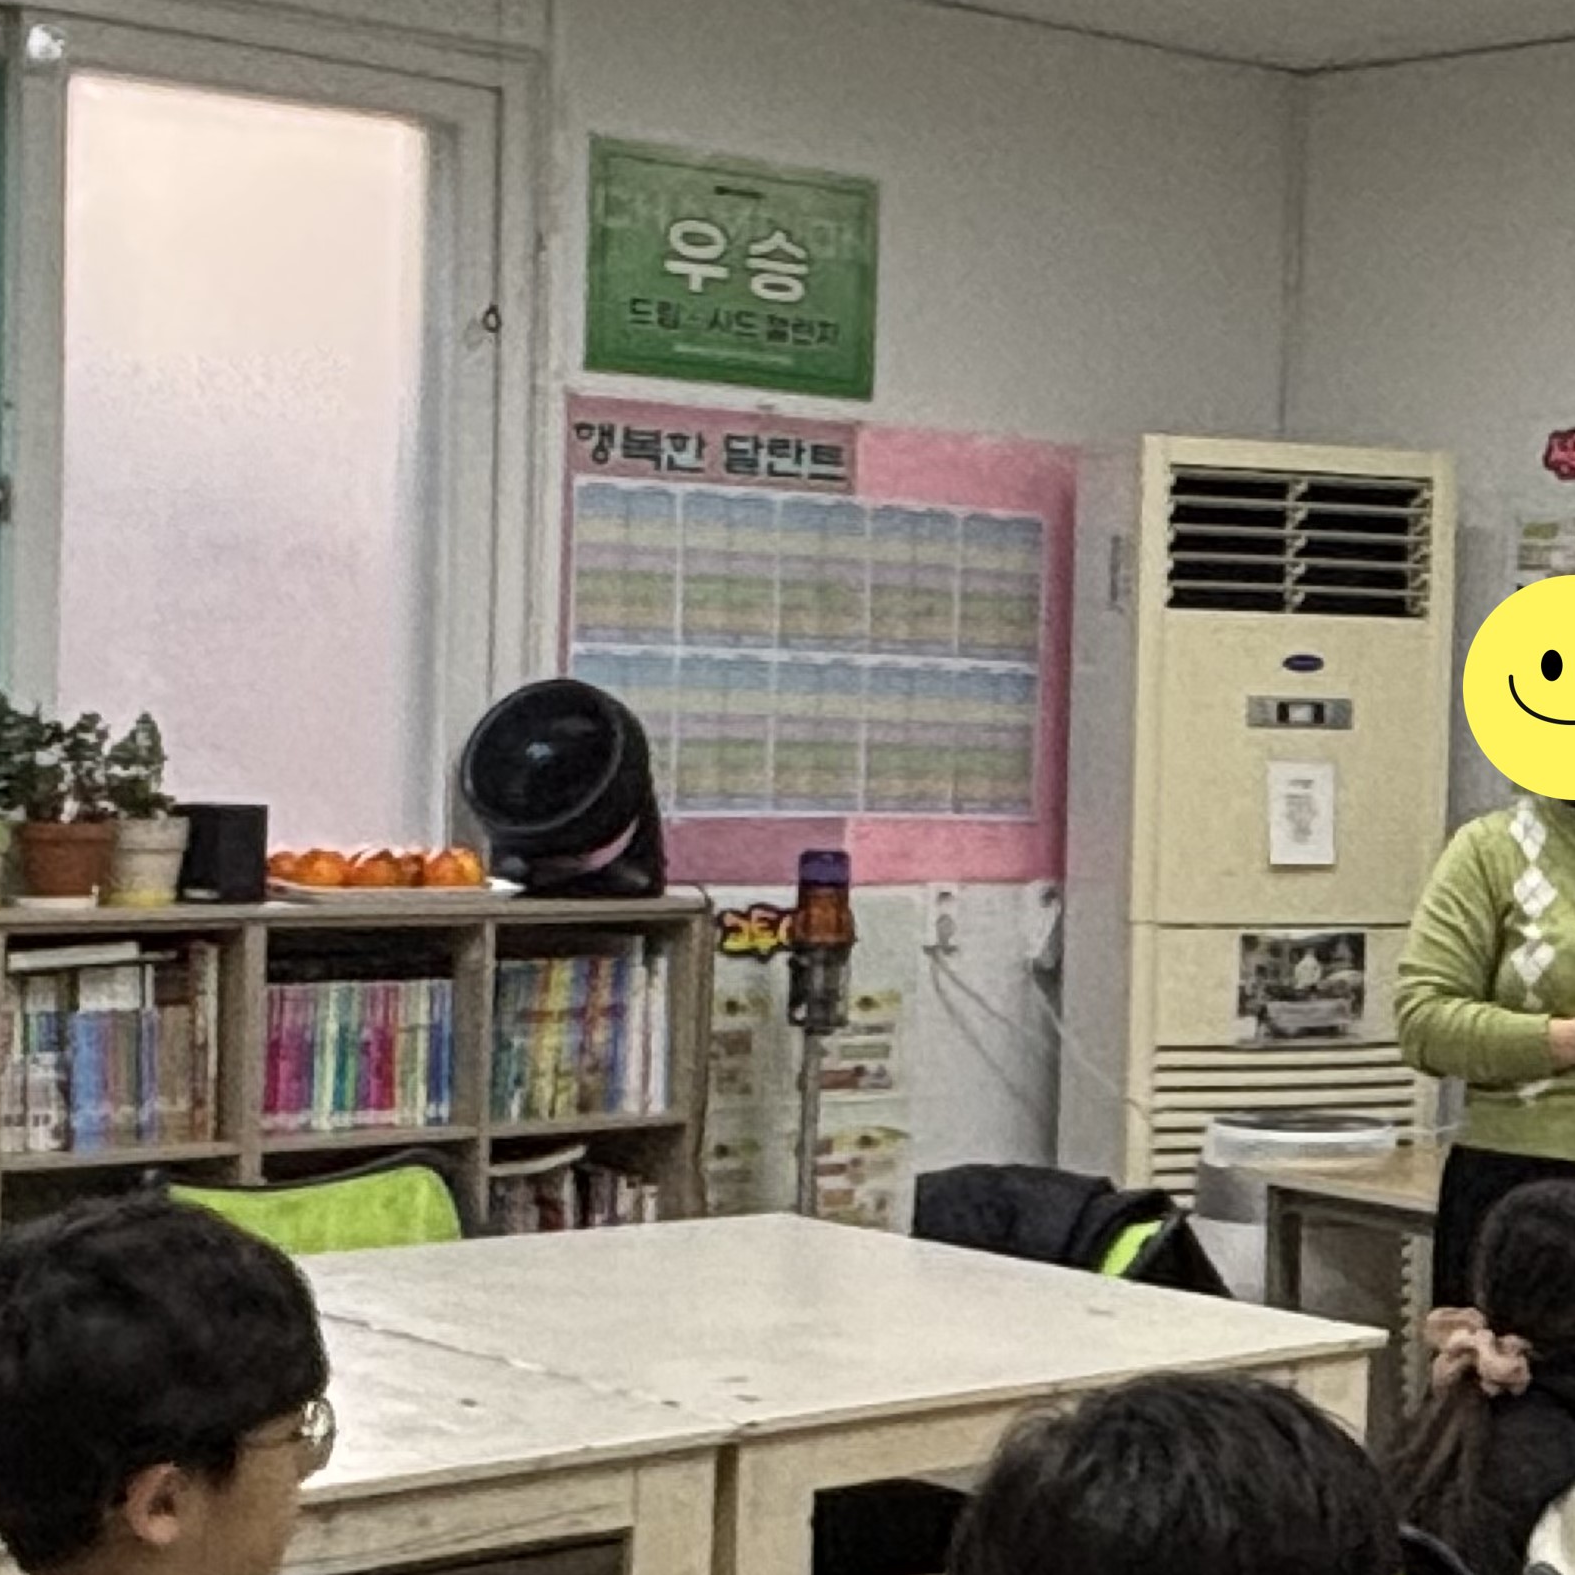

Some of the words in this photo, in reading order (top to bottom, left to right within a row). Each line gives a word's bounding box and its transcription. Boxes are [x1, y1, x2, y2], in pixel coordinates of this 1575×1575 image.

[663, 218, 810, 303] 우승
[574, 421, 707, 474] 행복한
[725, 432, 847, 481] 달란트
